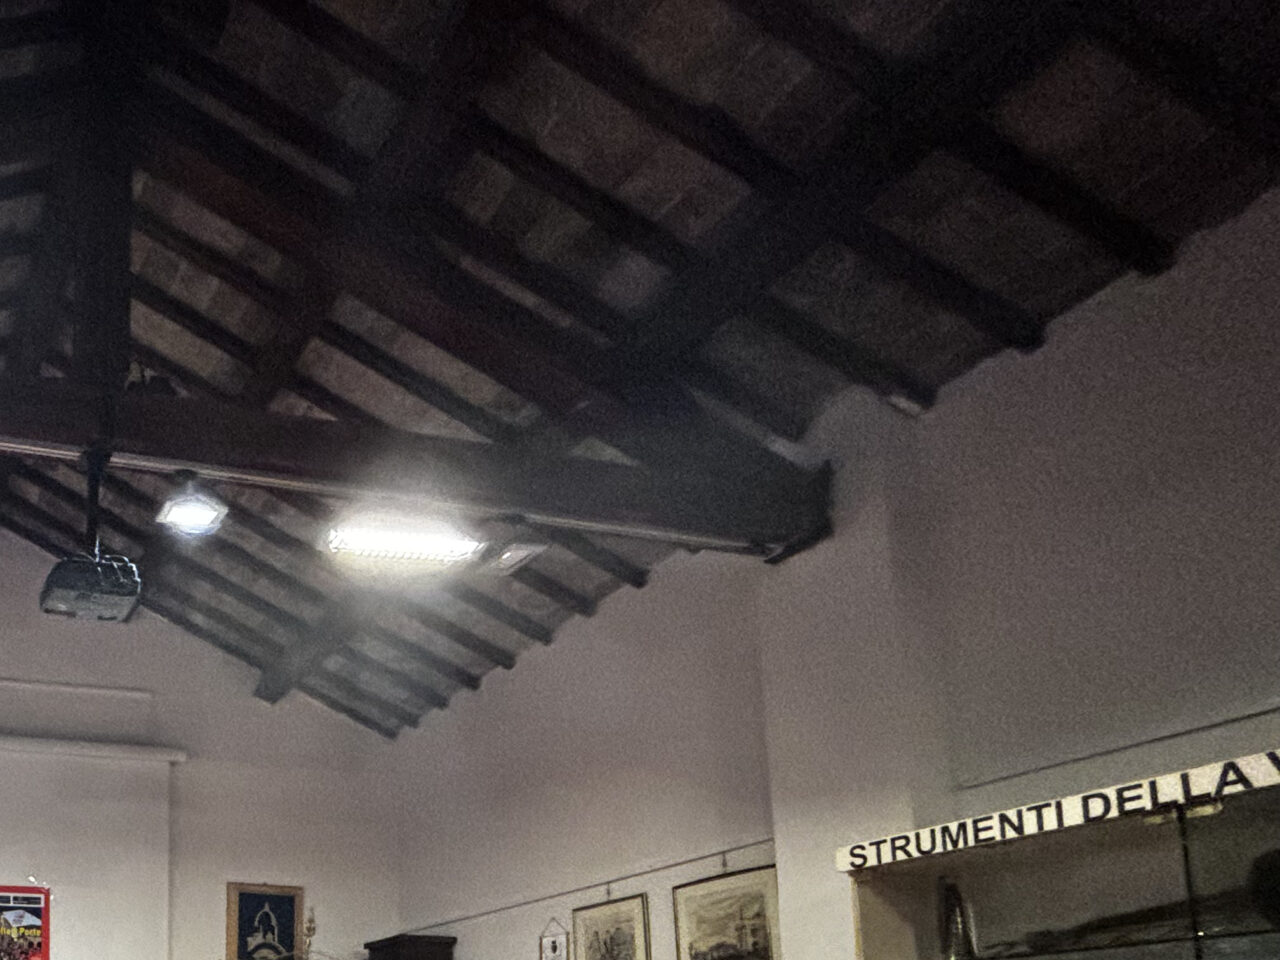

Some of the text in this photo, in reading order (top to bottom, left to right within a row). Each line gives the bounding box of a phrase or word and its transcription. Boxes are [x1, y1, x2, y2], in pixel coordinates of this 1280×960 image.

[849, 761, 1253, 869] STRUMENTI DELLA
[19, 927, 41, 936] Porte
